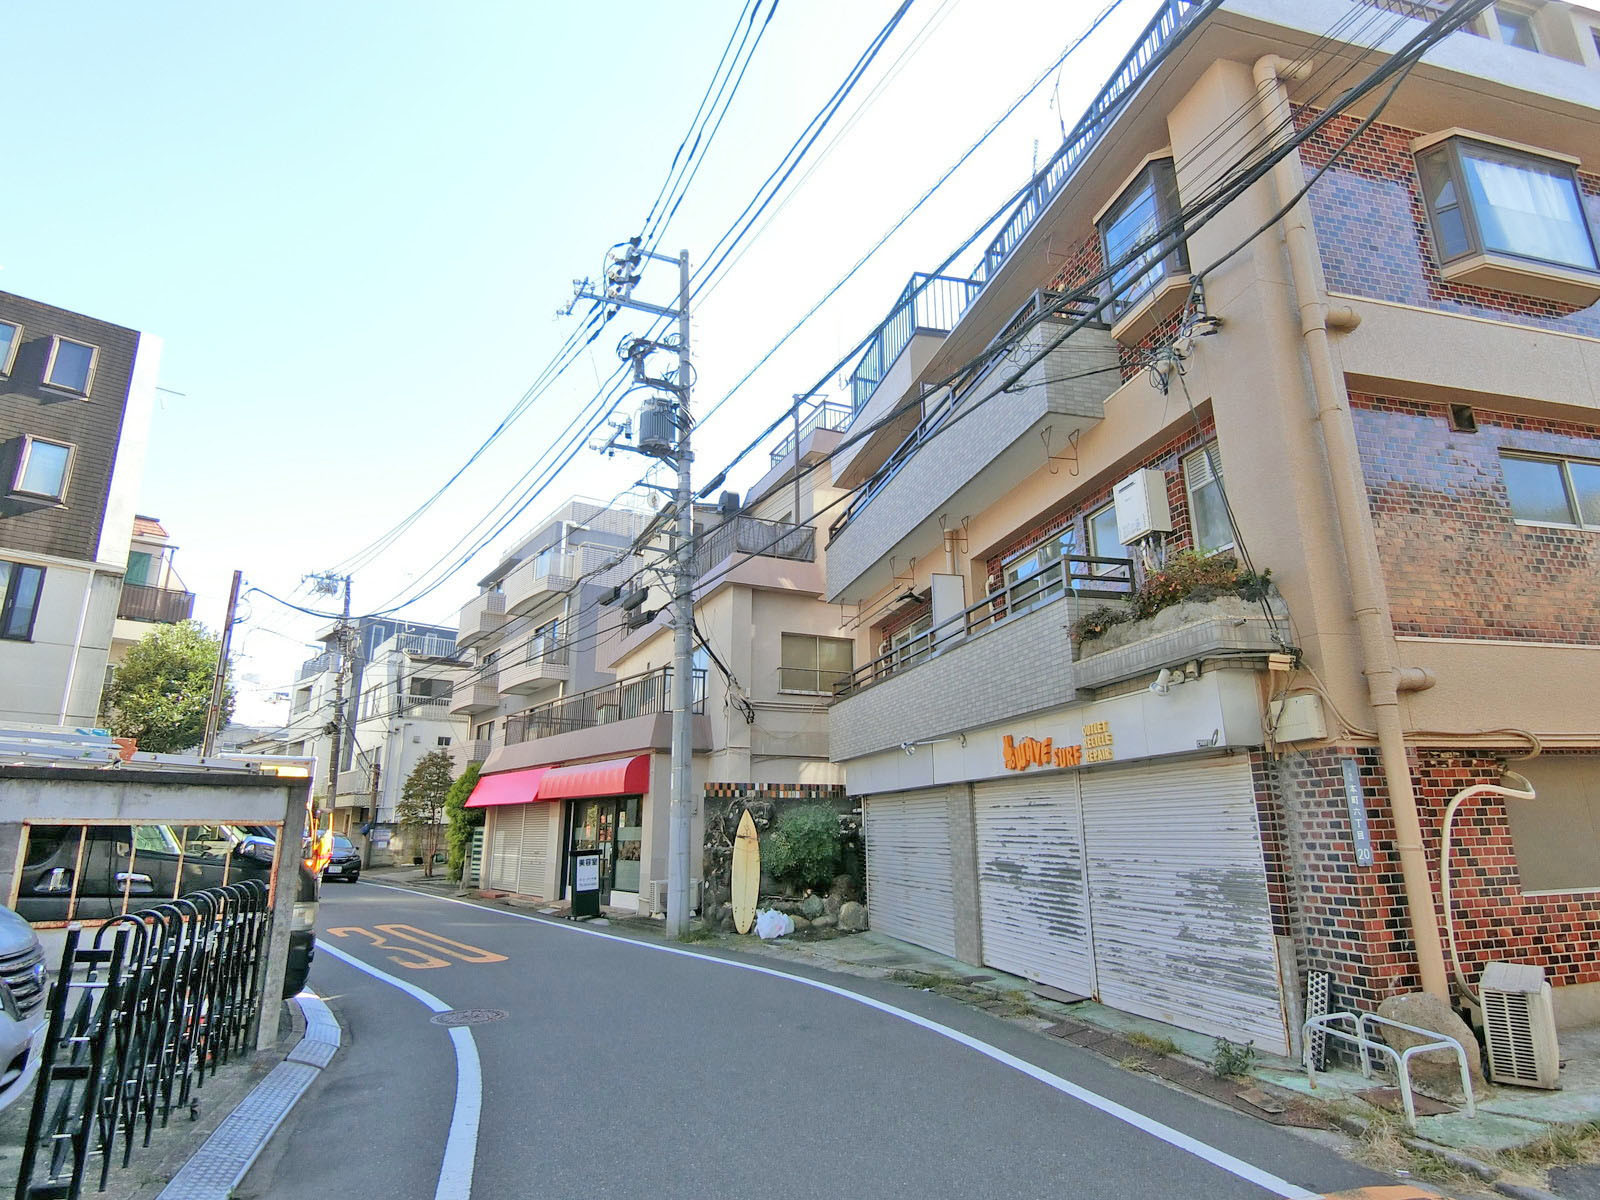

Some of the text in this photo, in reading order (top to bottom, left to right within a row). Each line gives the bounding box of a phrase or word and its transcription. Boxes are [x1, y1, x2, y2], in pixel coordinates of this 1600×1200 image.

[1083, 734, 1113, 749] RECYCLE
[1054, 744, 1082, 768] SURF
[1357, 848, 1370, 860] 20
[579, 857, 598, 867] 美容室
[326, 924, 509, 969] 30
